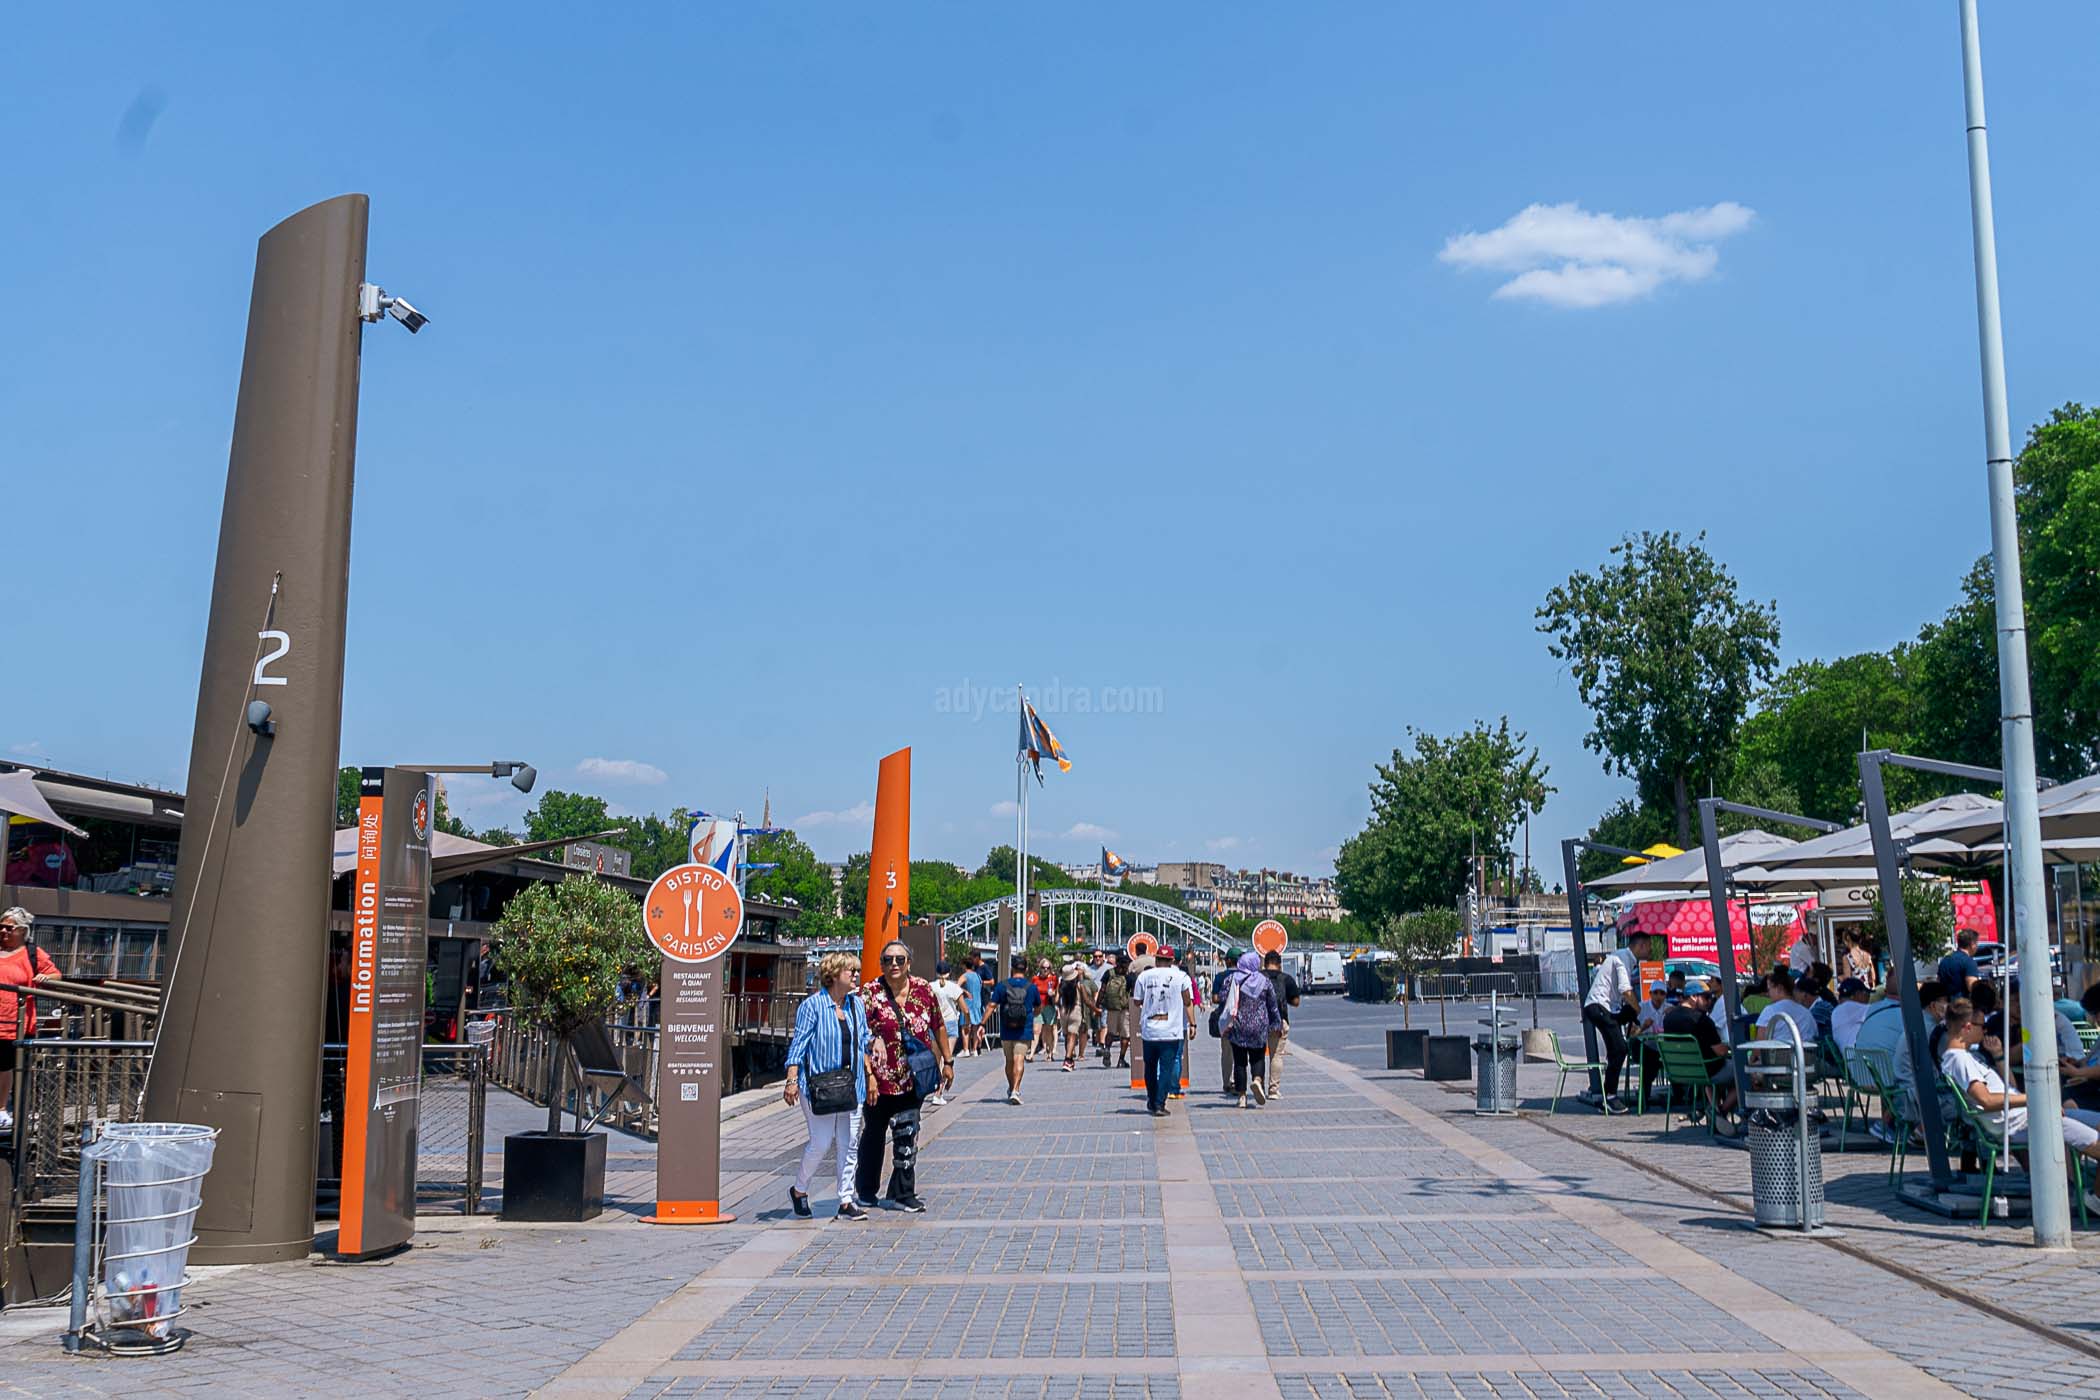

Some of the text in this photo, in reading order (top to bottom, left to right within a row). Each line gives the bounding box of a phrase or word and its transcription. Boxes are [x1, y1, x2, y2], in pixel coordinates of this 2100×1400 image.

[253, 629, 291, 686] 2
[361, 814, 379, 860] 问询处
[885, 871, 897, 889] 3
[1027, 912, 1035, 923] 4
[352, 881, 377, 1013] Information
[662, 931, 727, 956] PARISIEN
[673, 972, 712, 980] RESTAURANT
[667, 1023, 715, 1033] BIENVENUE
[674, 1034, 709, 1043] WELCOME
